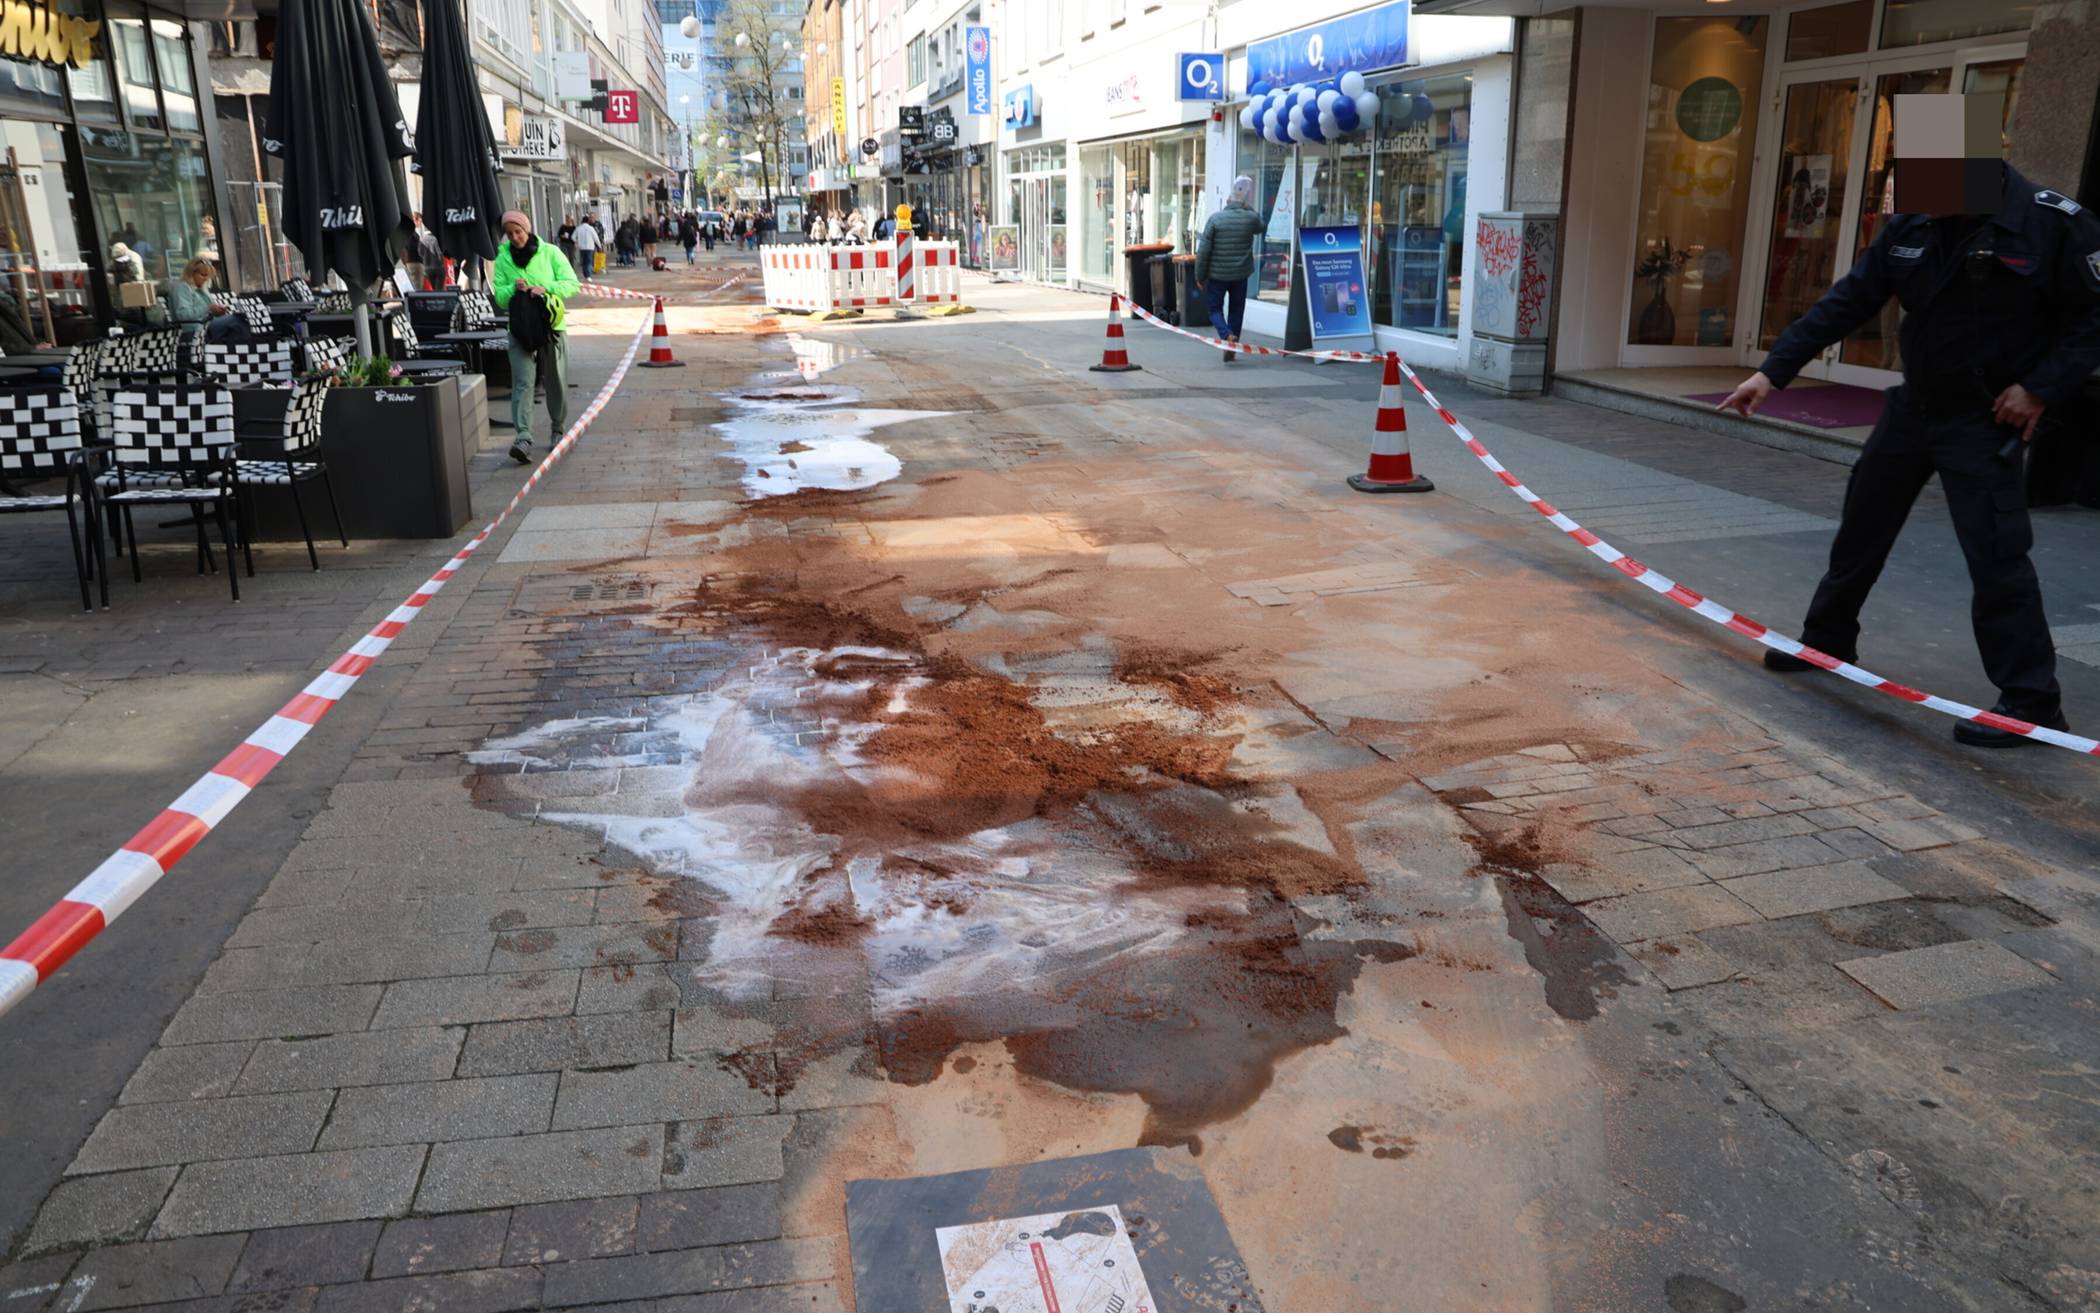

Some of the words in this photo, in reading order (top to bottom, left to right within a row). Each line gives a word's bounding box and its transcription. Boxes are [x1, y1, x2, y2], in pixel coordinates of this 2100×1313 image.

[972, 68, 987, 113] Apollo
[1186, 59, 1218, 94] O2
[612, 95, 631, 119] T
